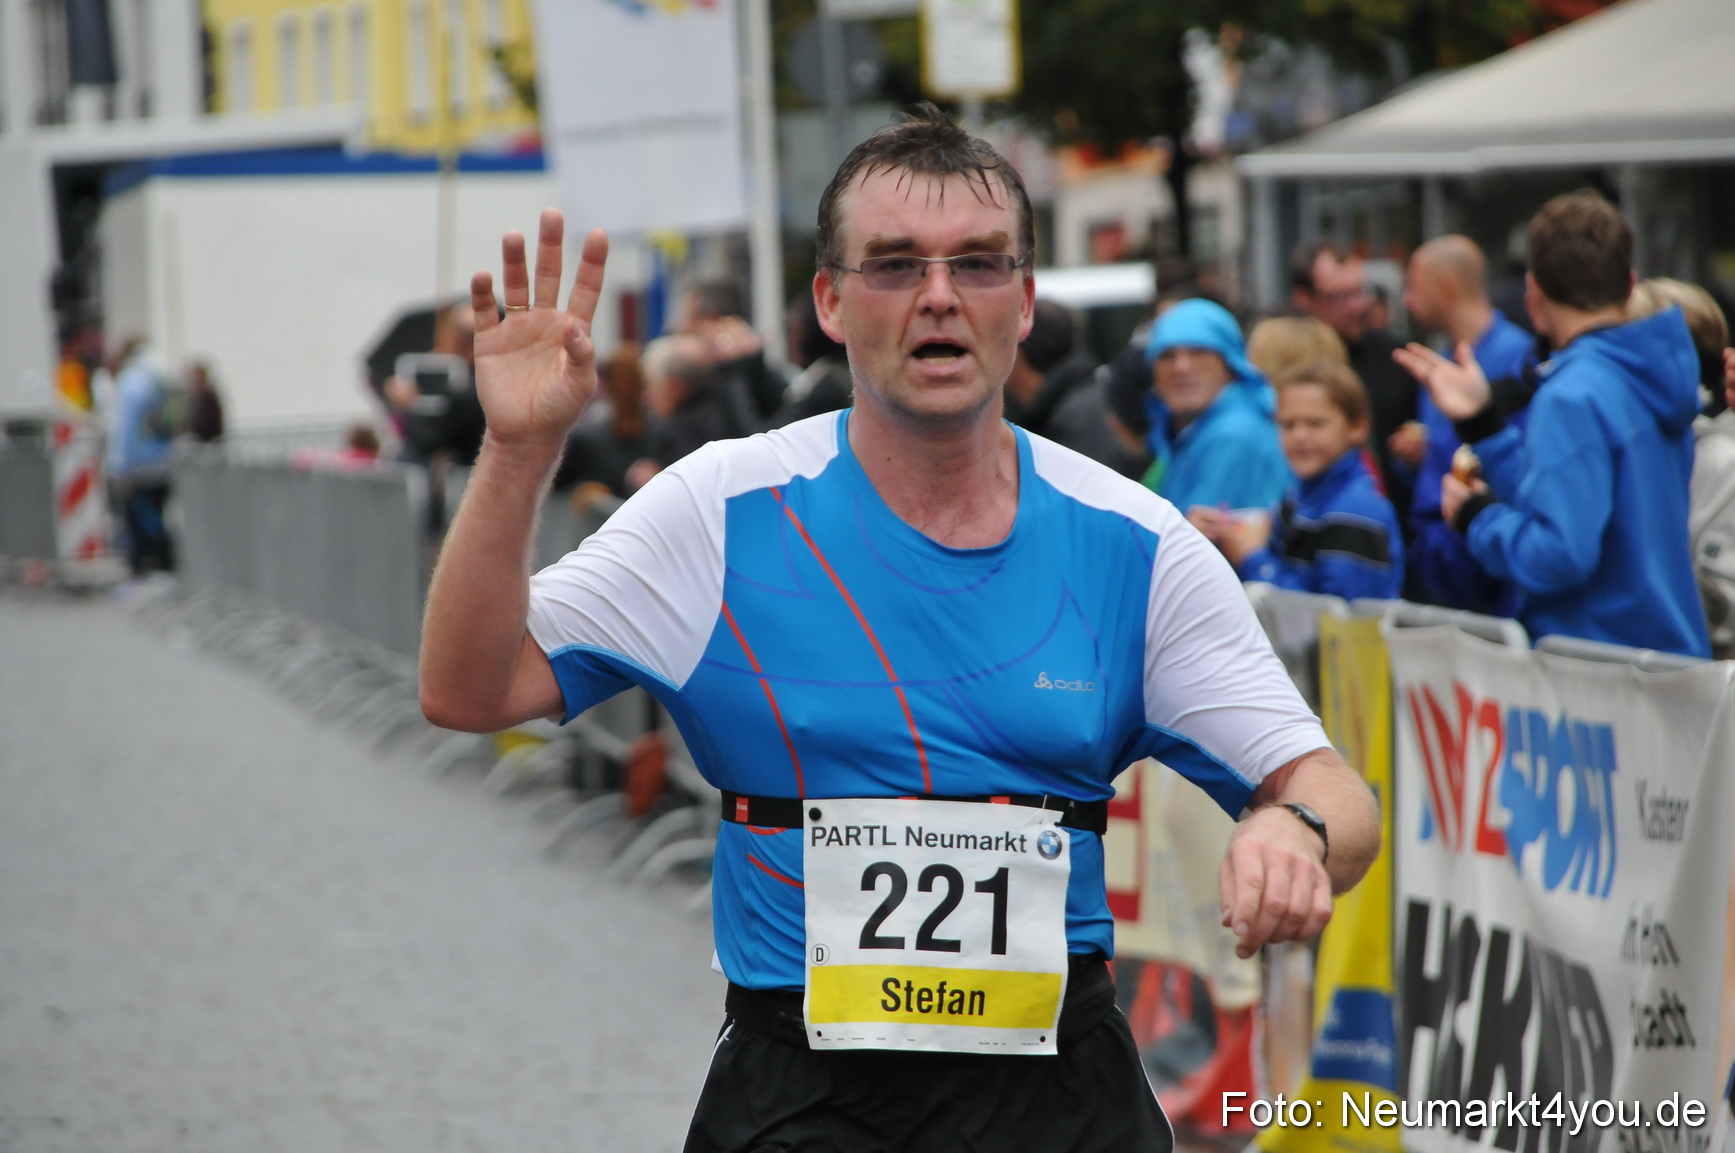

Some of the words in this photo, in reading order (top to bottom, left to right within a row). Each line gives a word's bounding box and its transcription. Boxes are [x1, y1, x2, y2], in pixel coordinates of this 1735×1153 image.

[811, 825, 897, 847] PARTL
[905, 826, 1027, 853] Neumarkt
[858, 861, 1009, 956] 221
[815, 947, 824, 962] D
[881, 977, 986, 1016] Stefan
